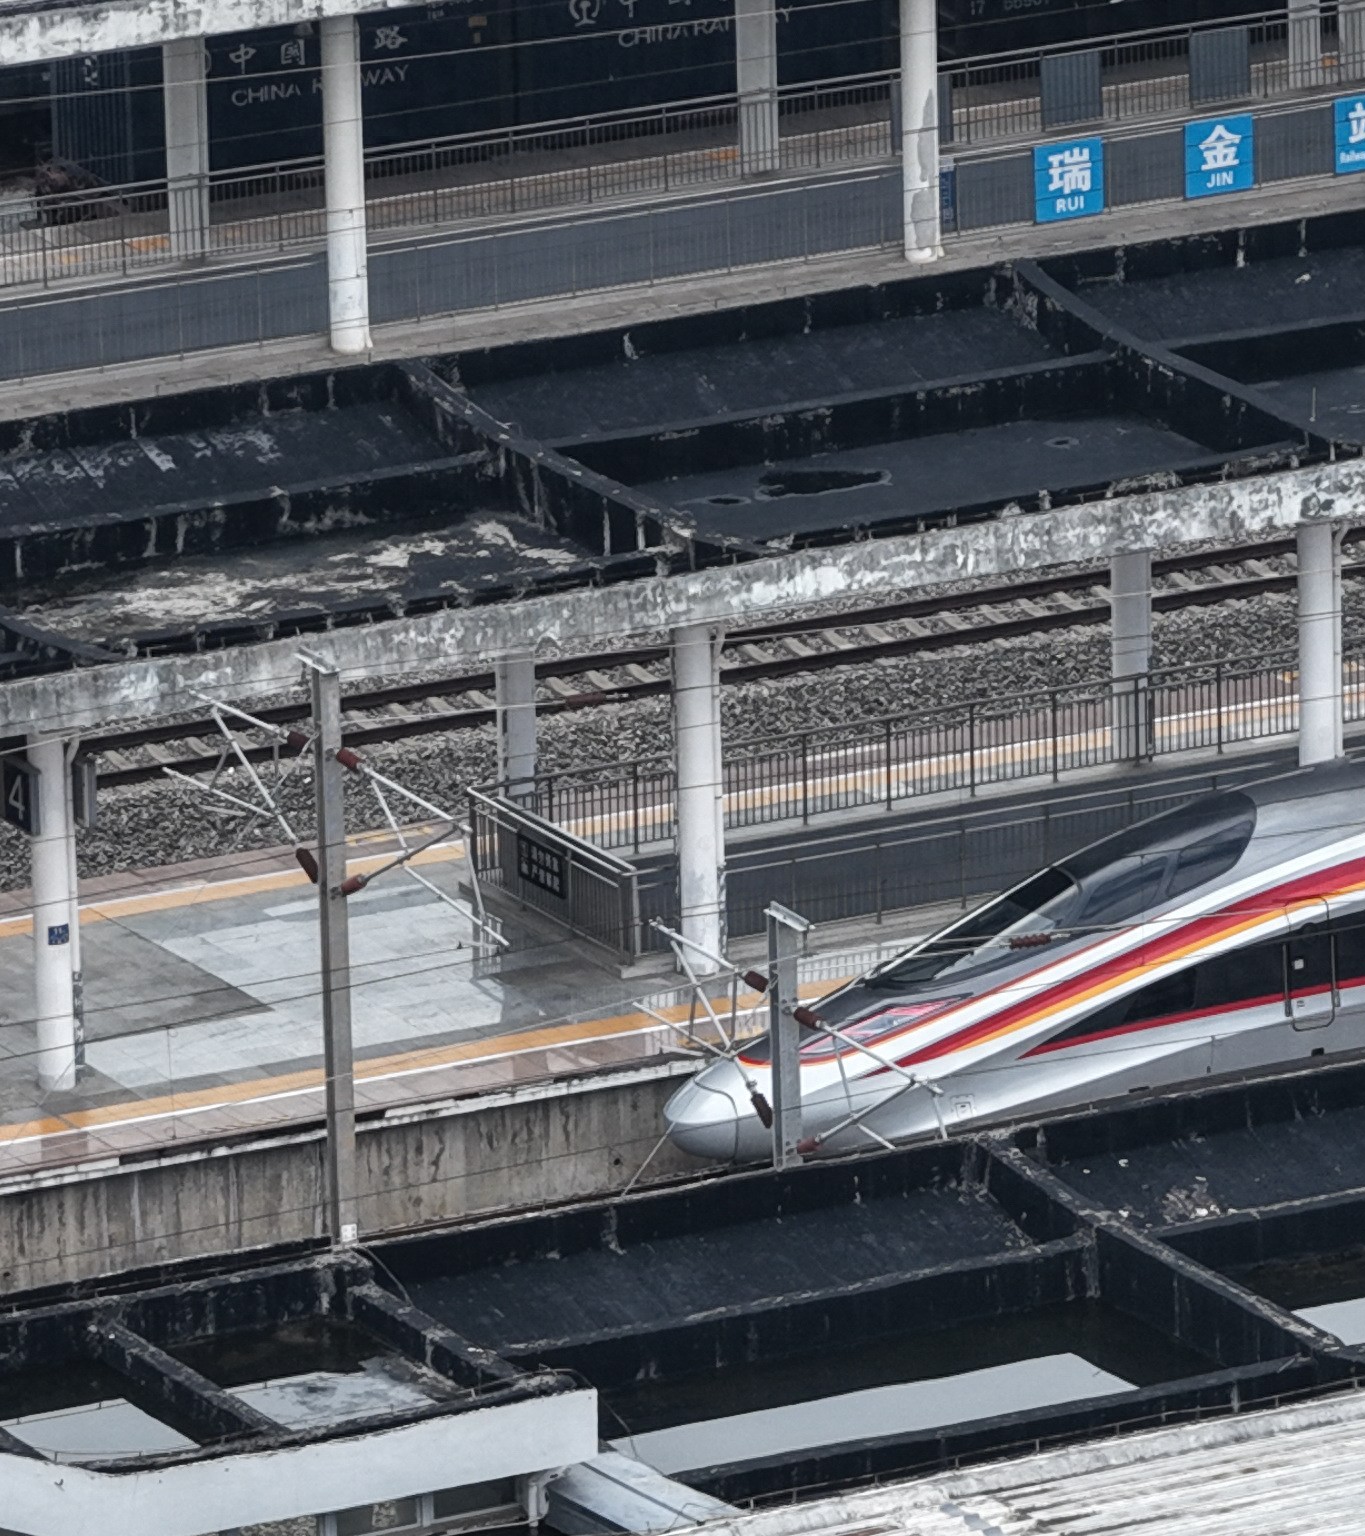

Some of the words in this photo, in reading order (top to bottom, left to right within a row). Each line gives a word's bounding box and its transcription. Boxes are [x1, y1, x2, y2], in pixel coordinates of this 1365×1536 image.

[231, 83, 301, 107] CHINA
[1198, 124, 1241, 171] 金
[1048, 146, 1092, 195] 瑞
[1206, 170, 1234, 188] JIN
[1056, 195, 1084, 213] RUI
[8, 774, 25, 820] 4
